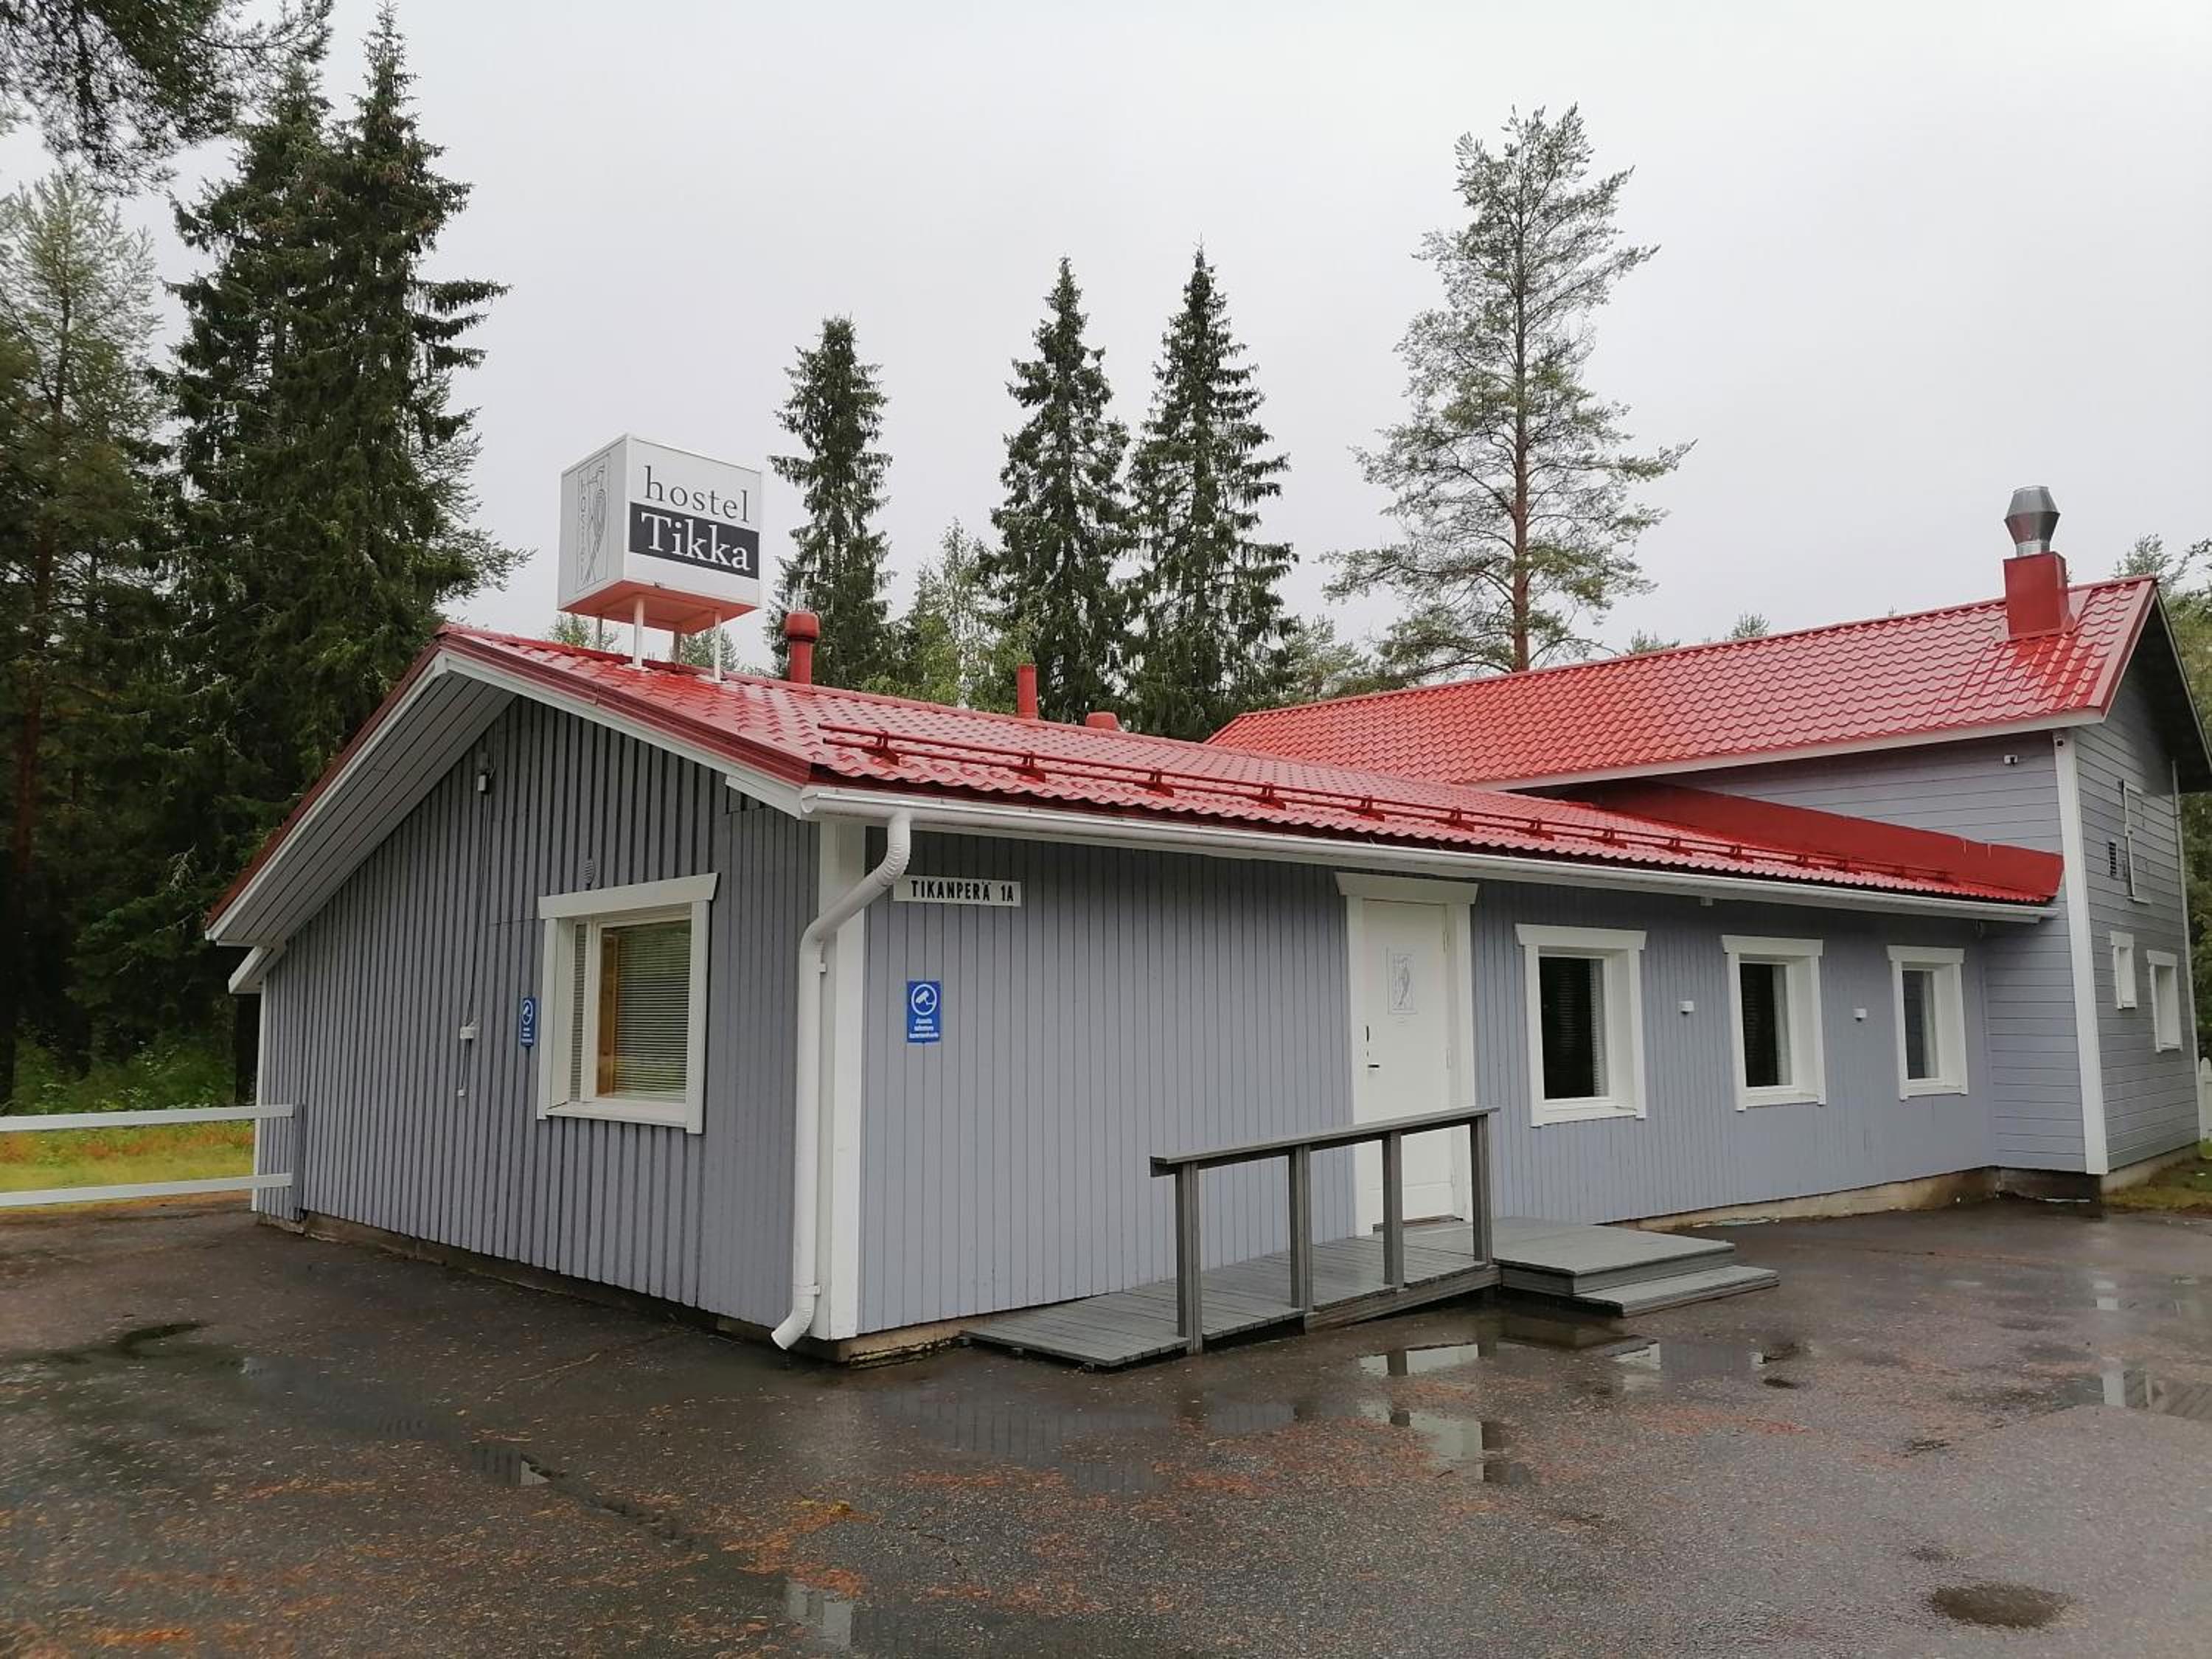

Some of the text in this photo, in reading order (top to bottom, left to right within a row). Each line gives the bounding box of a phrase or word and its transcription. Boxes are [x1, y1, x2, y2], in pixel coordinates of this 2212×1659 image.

[644, 465, 749, 522] hostel
[641, 512, 751, 571] Tikka
[911, 880, 1014, 902] TIKANPERÄ 1A
